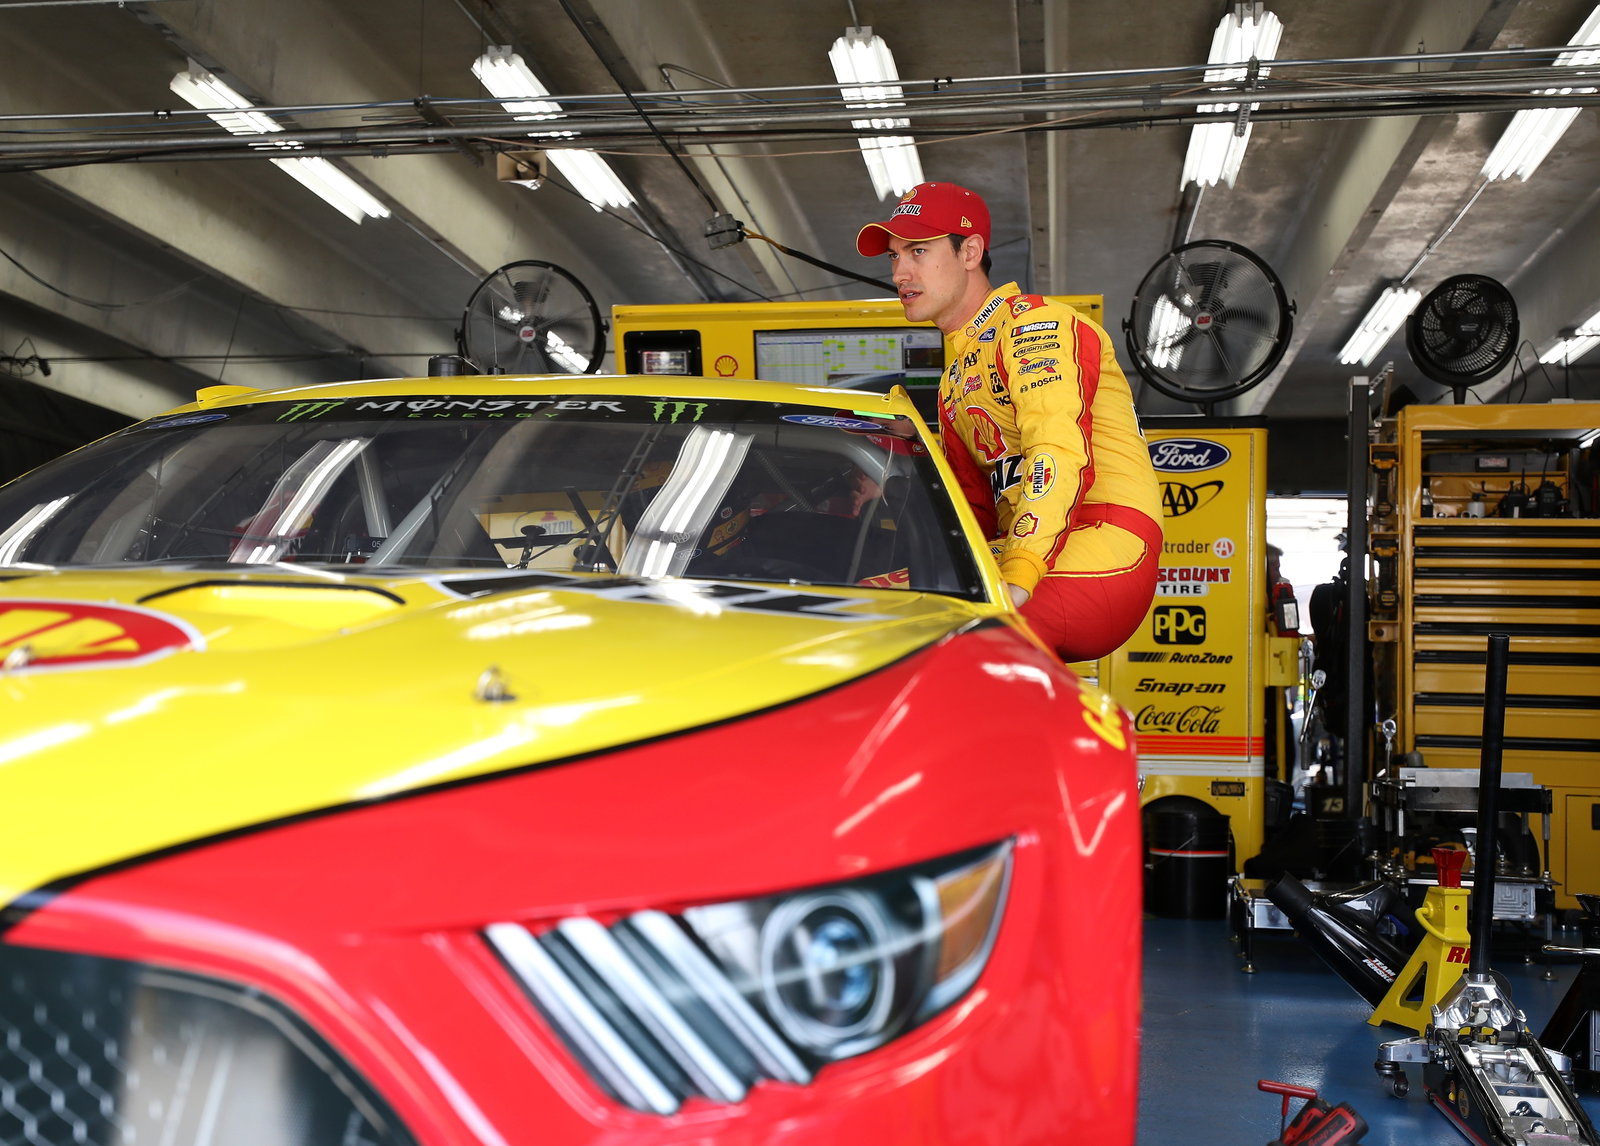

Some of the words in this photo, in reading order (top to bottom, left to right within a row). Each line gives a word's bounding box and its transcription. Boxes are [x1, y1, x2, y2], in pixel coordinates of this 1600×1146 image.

[974, 296, 1005, 328] PENNZOIL
[1022, 322, 1057, 333] NASCAR
[1012, 335, 1058, 347] Snap-on
[1021, 359, 1056, 373] SUNOCO
[1031, 375, 1062, 389] BOSCH
[802, 416, 863, 428] Ford
[1152, 443, 1211, 466] Ford
[1033, 459, 1044, 494] PENNZOIL
[1161, 540, 1210, 554] trader
[1160, 585, 1202, 594] TIRE
[1155, 608, 1204, 642] PPG
[1169, 652, 1233, 664] AutoZone
[1135, 678, 1226, 696] Snap-on
[1134, 704, 1225, 733] Coca-Cola
[1361, 958, 1396, 984] PENSKE
[1371, 957, 1397, 977] TEAM
